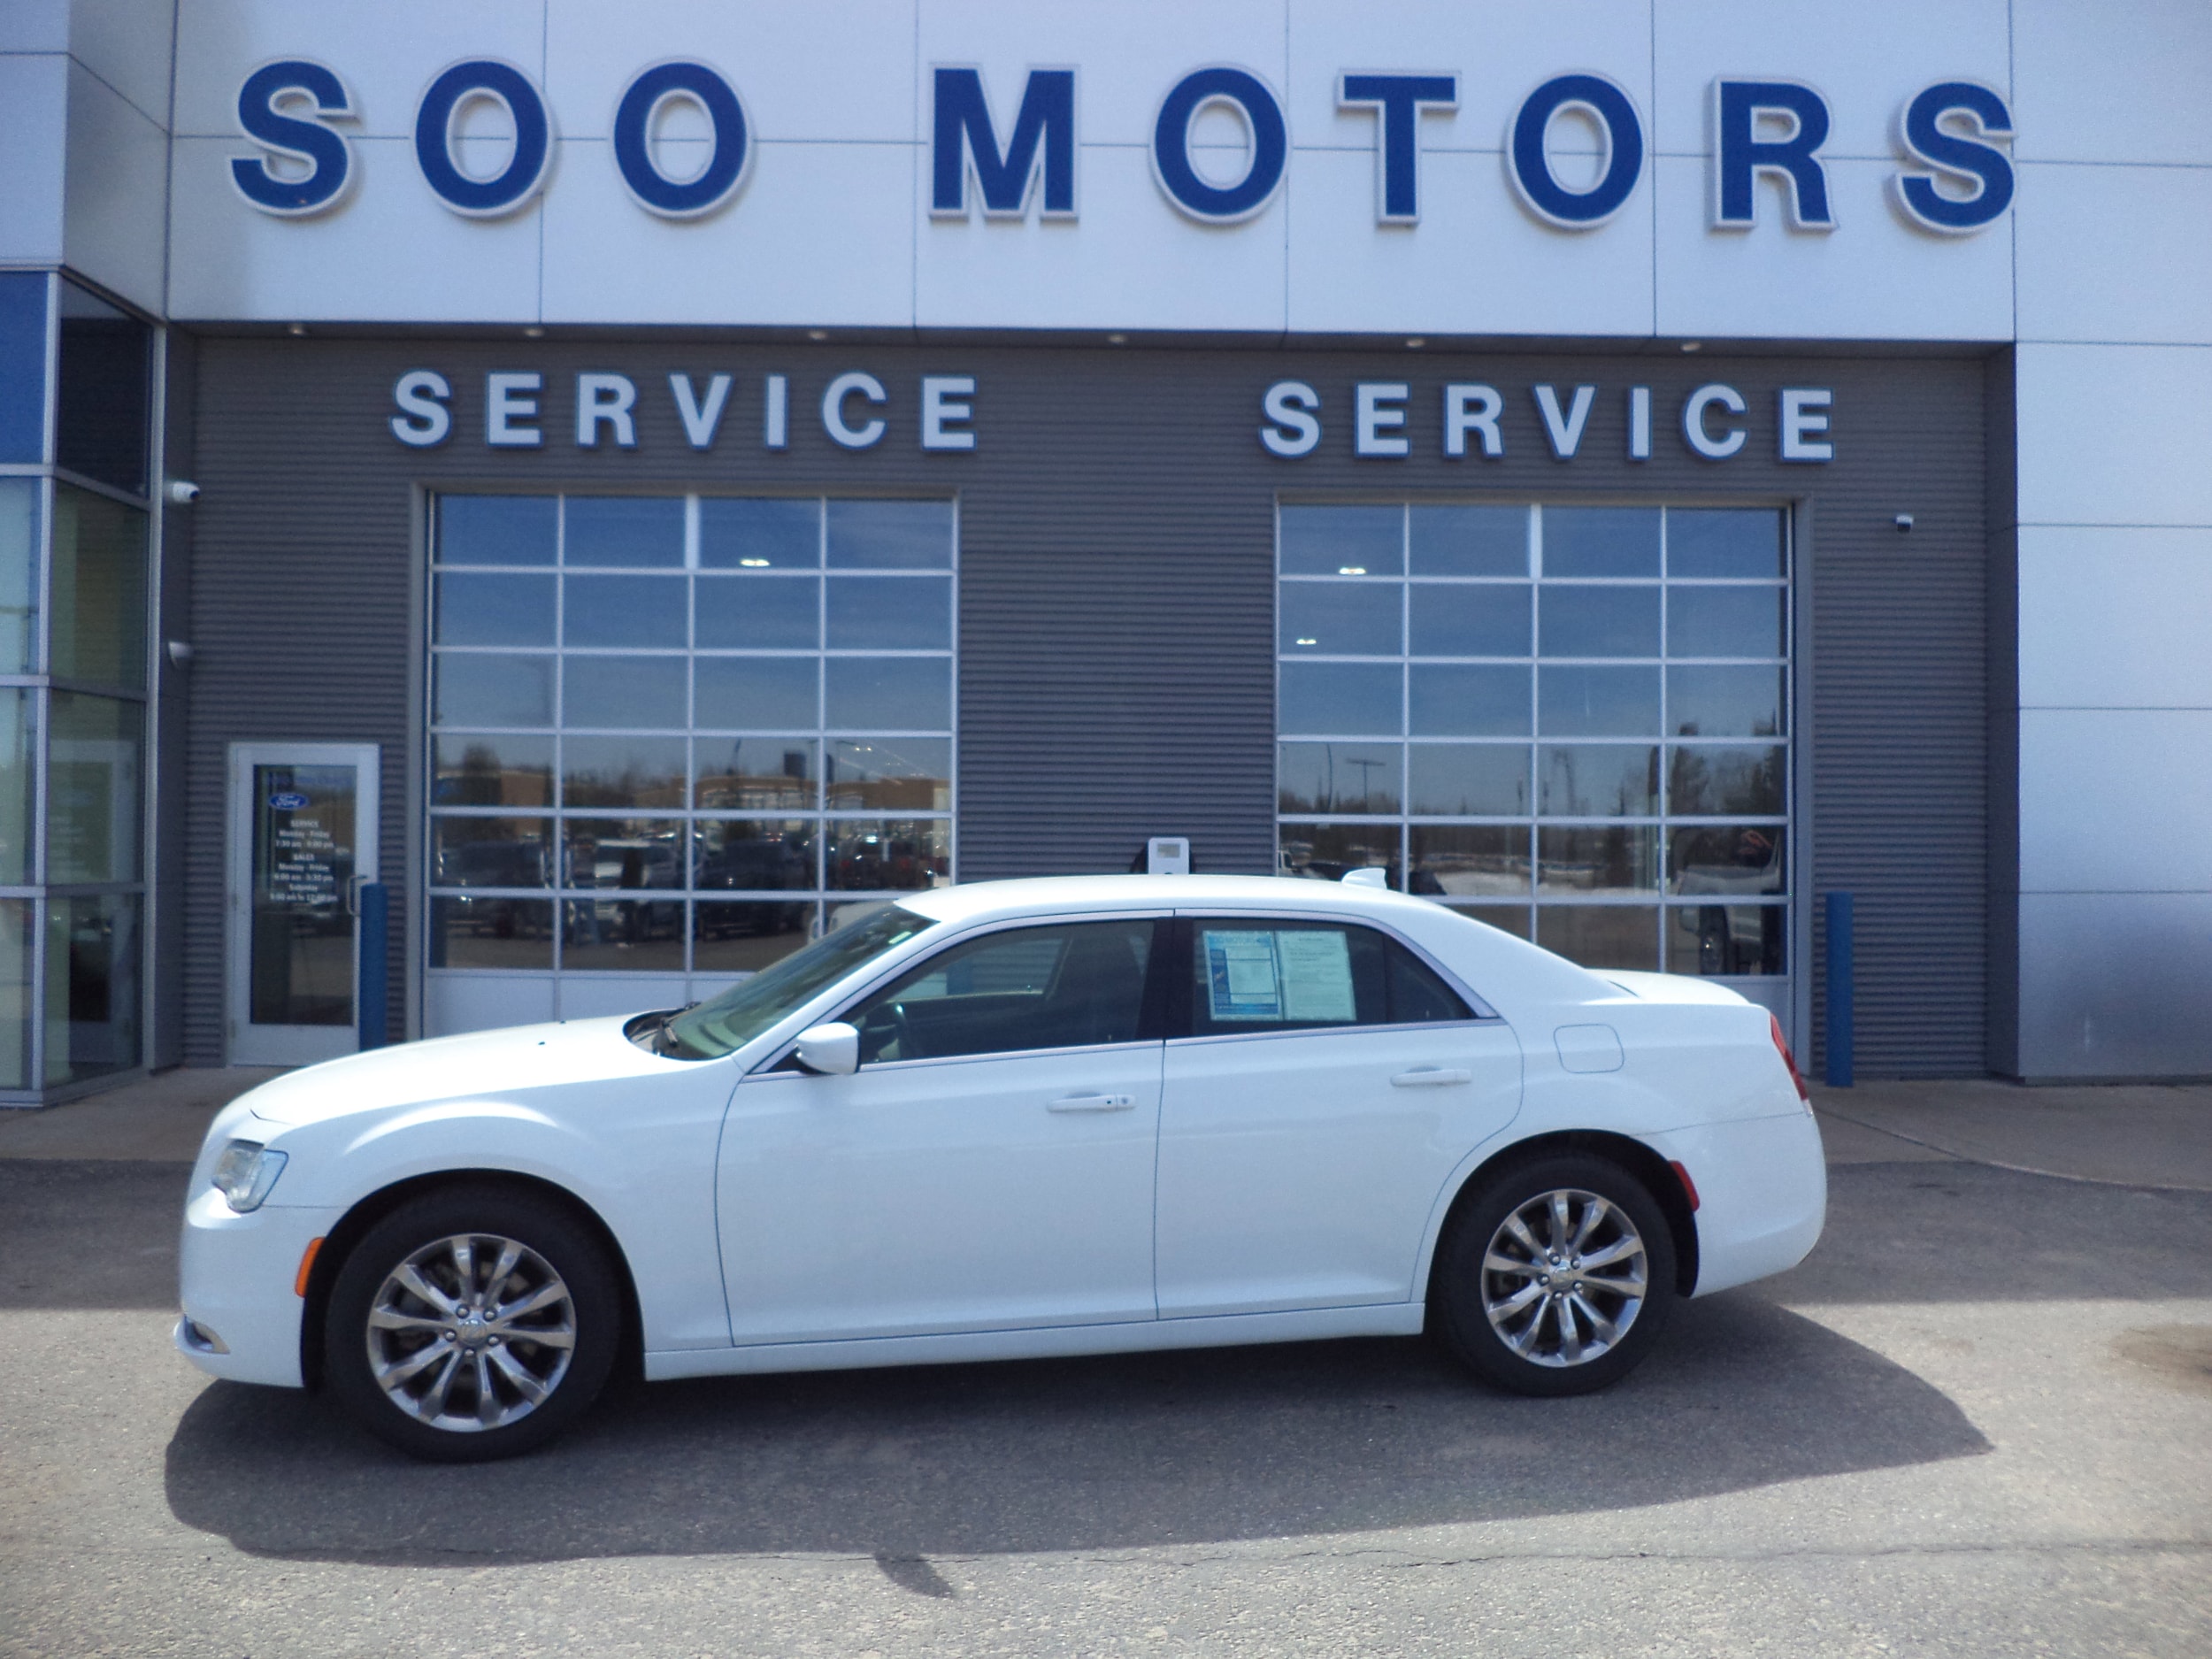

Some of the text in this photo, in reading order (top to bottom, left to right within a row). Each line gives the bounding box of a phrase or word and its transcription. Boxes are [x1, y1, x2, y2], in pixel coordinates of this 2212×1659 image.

[230, 57, 2016, 235] SOO MOTORS
[389, 370, 977, 449] SERVICE
[1260, 380, 1834, 461] SERVICE
